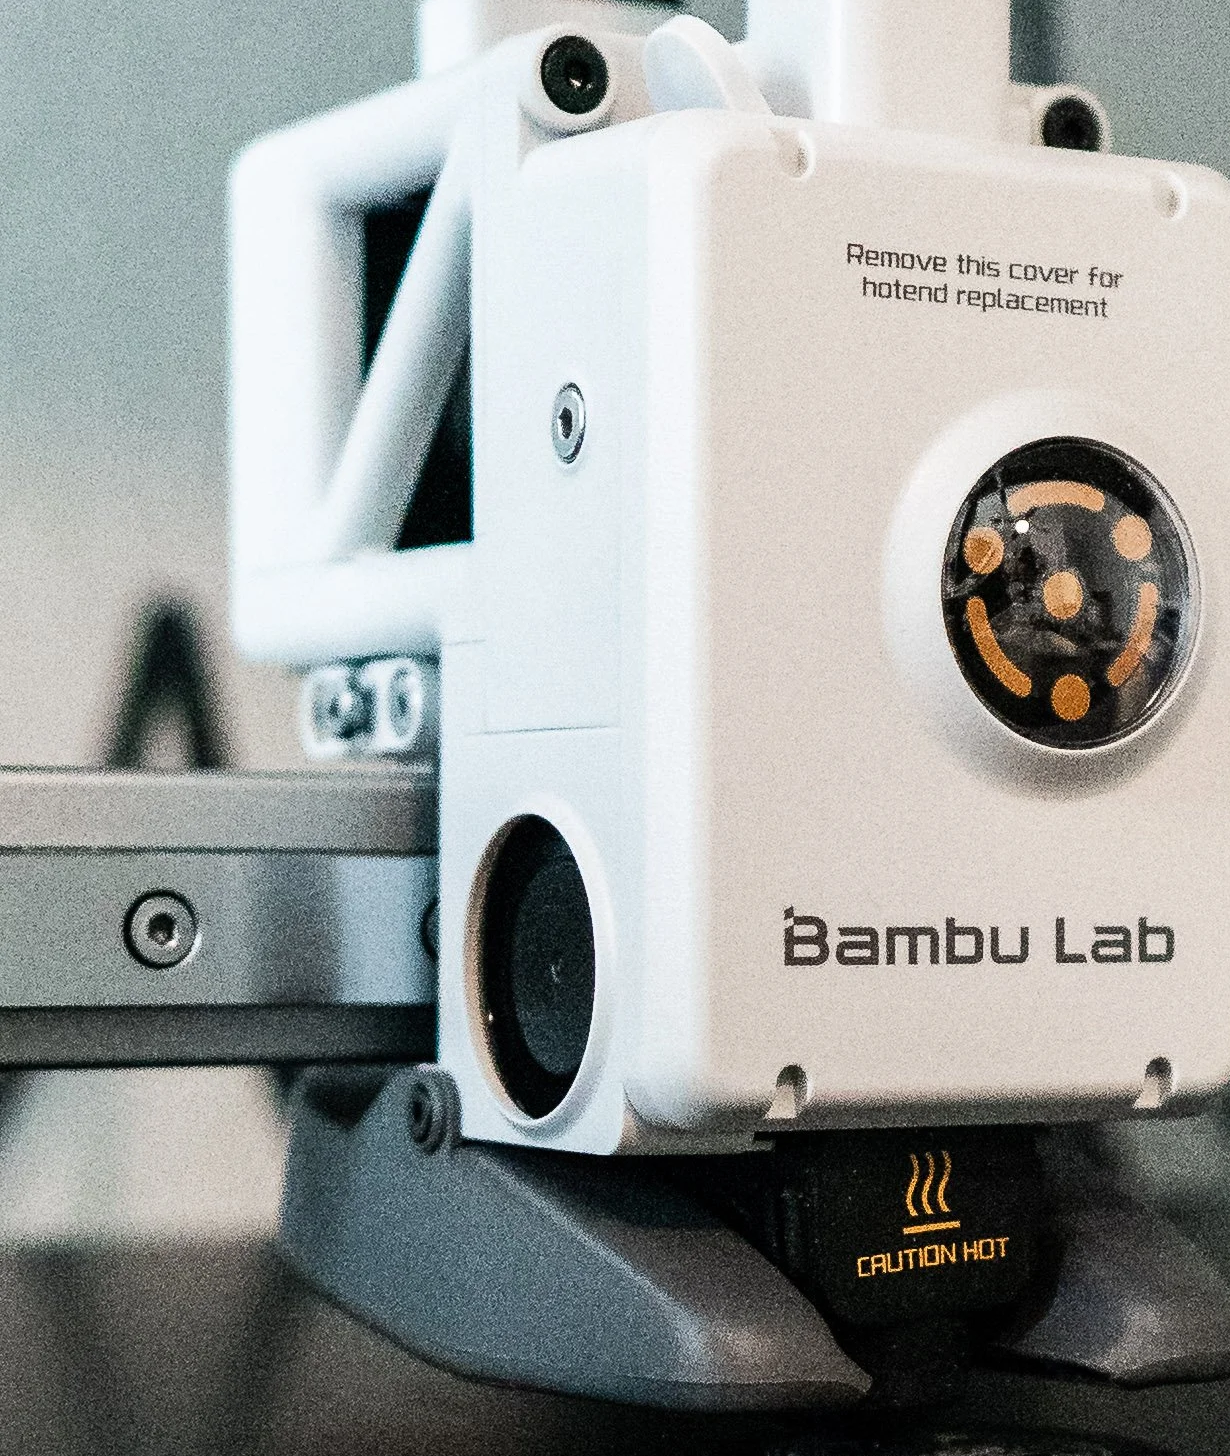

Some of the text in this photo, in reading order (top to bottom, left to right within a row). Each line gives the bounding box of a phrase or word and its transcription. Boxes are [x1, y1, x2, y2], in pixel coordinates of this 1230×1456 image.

[846, 242, 1124, 289] Remove this cover for
[862, 276, 1109, 319] hotend replacement
[783, 905, 1176, 967] Bambu Lab
[857, 1236, 1010, 1278] CAUTION HOT
